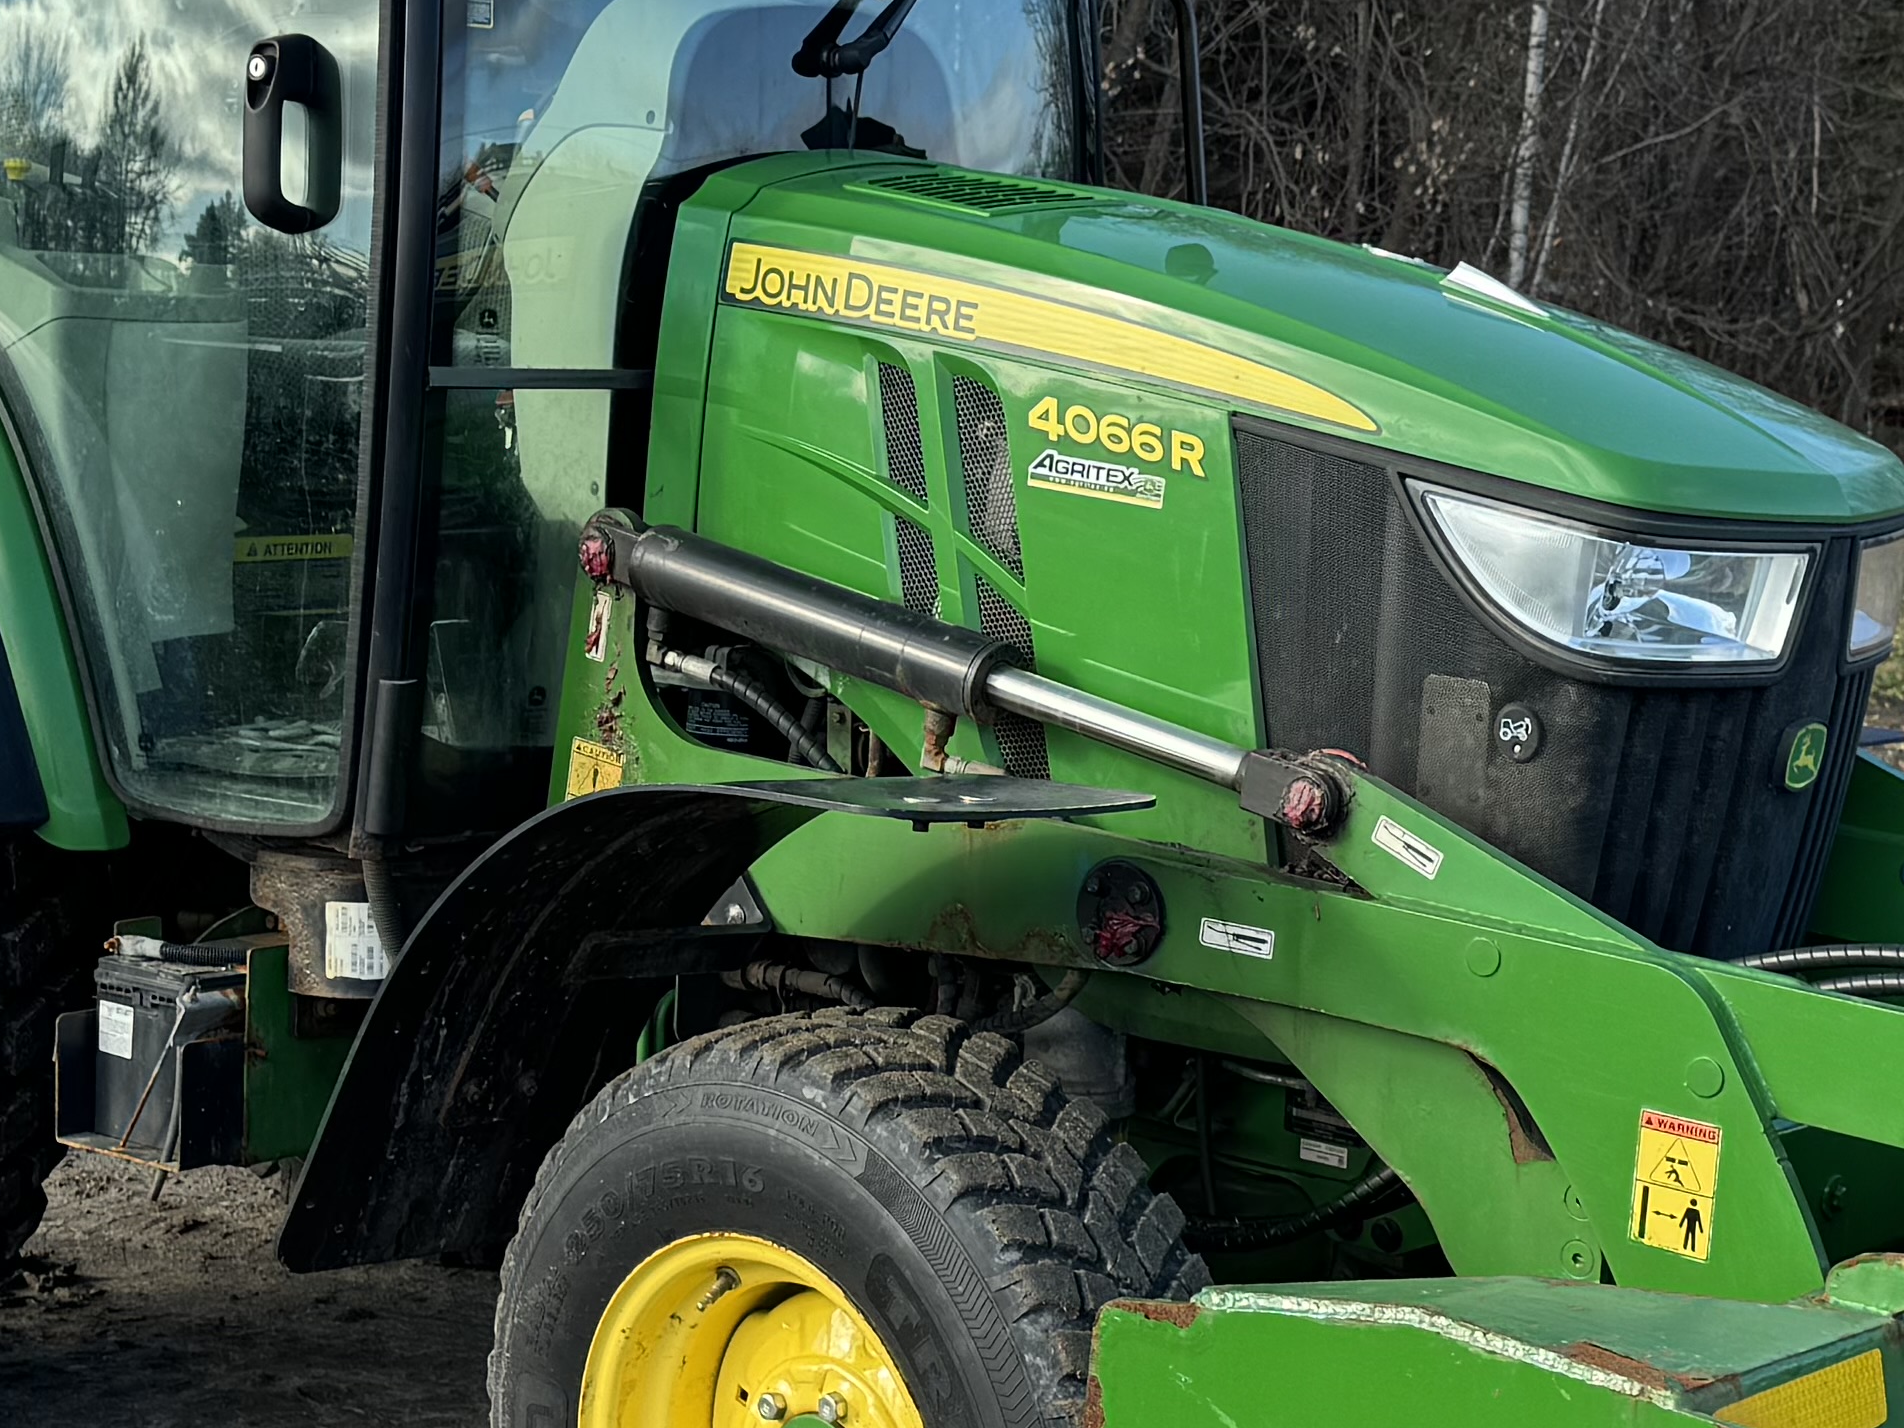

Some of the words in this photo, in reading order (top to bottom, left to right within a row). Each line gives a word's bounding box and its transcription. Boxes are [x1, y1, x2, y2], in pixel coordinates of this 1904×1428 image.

[739, 257, 839, 310] JOHN
[844, 271, 980, 336] DEERE
[1033, 453, 1136, 497] AGRITEX
[263, 541, 332, 557] ATTENTION
[582, 744, 622, 764] CAUTION
[700, 1092, 820, 1138] ROTATION
[1657, 1118, 1717, 1141] WARNING
